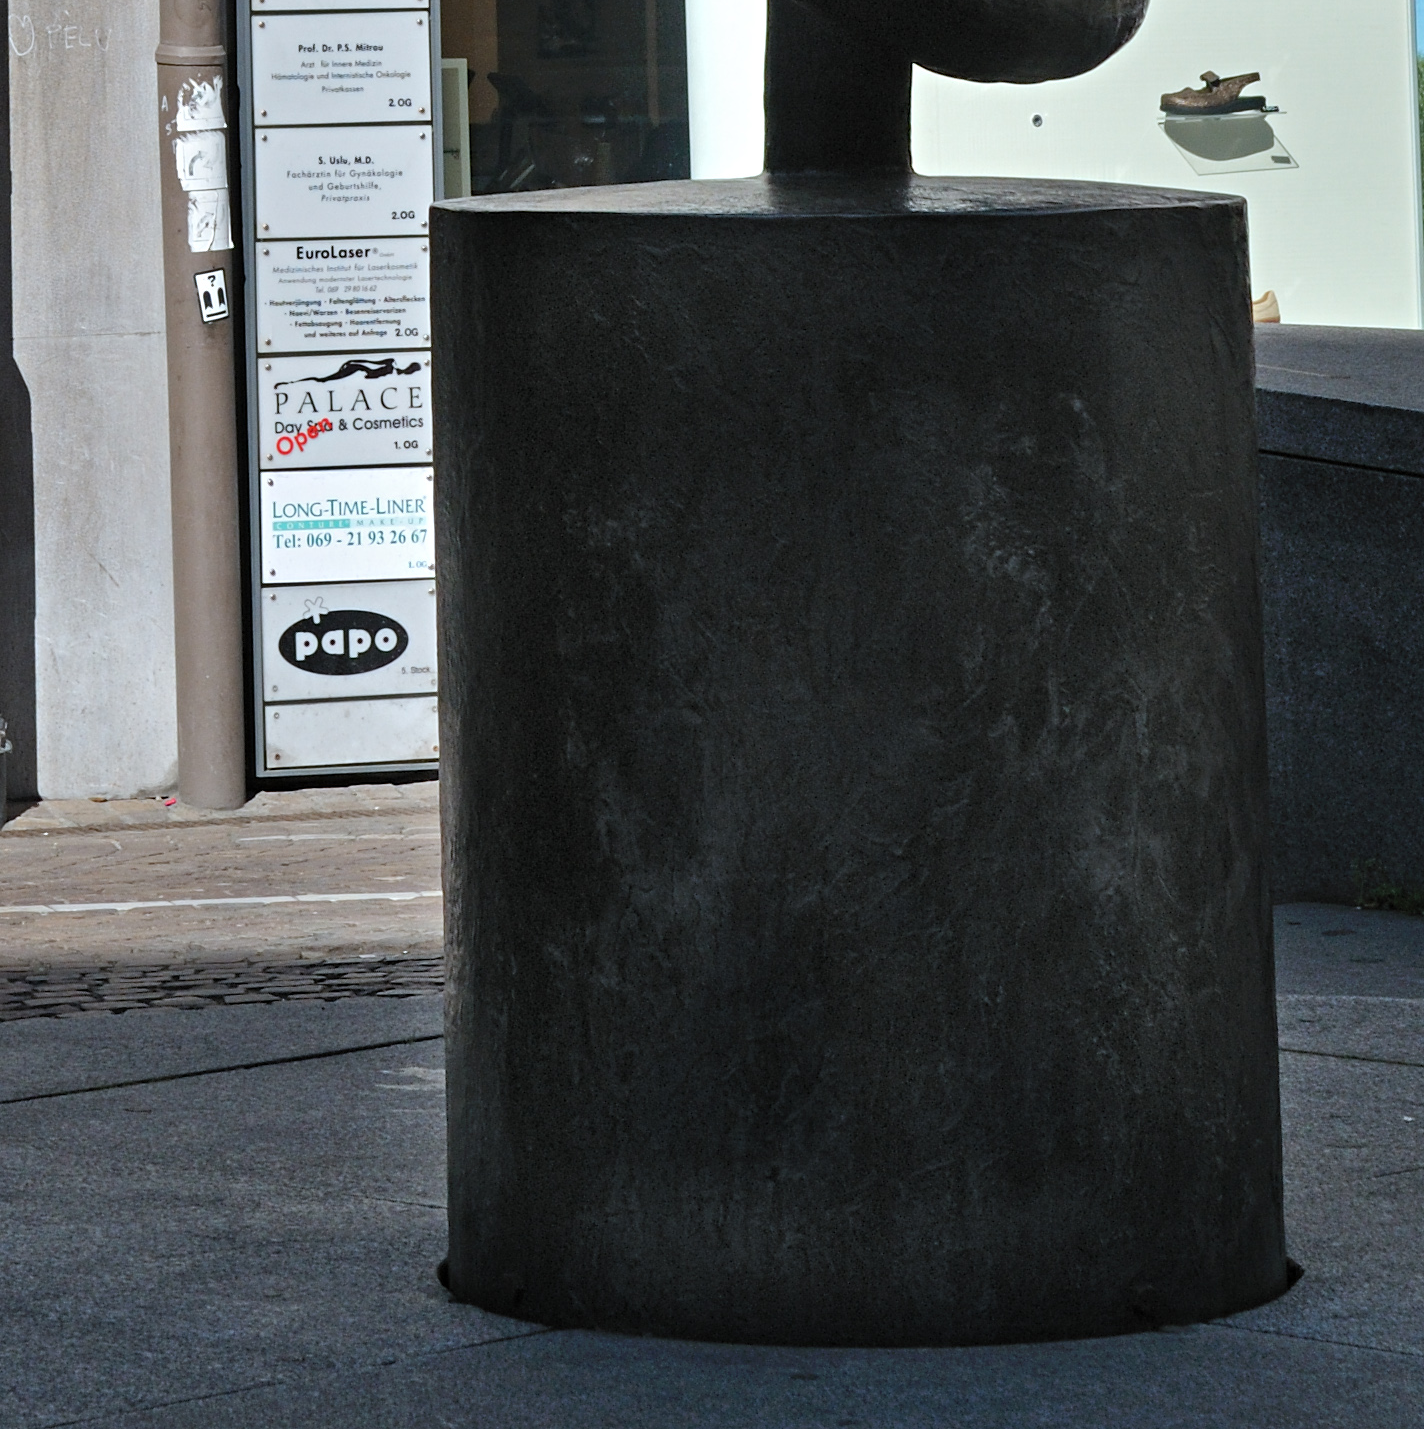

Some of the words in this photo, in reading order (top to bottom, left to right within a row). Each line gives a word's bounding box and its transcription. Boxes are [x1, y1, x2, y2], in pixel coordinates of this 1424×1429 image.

[298, 43, 319, 53] Prof.
[318, 156, 327, 166] S.
[287, 169, 332, 179] Fachärztin
[334, 169, 345, 178] für
[349, 168, 404, 179] Gynäkologie
[296, 245, 371, 260] EuroLaser
[274, 386, 423, 415] PALACE
[274, 421, 302, 435] Day
[338, 418, 348, 431] &
[352, 415, 424, 431] Cosmetics
[275, 417, 333, 455] Open
[272, 496, 426, 518] LONG-TIME-LINER
[272, 534, 302, 549] Tel:
[306, 532, 332, 547] 069
[347, 531, 362, 546] 21
[368, 530, 384, 545] 93
[390, 529, 406, 544] 26
[411, 529, 428, 543] 67
[295, 627, 398, 662] papo
